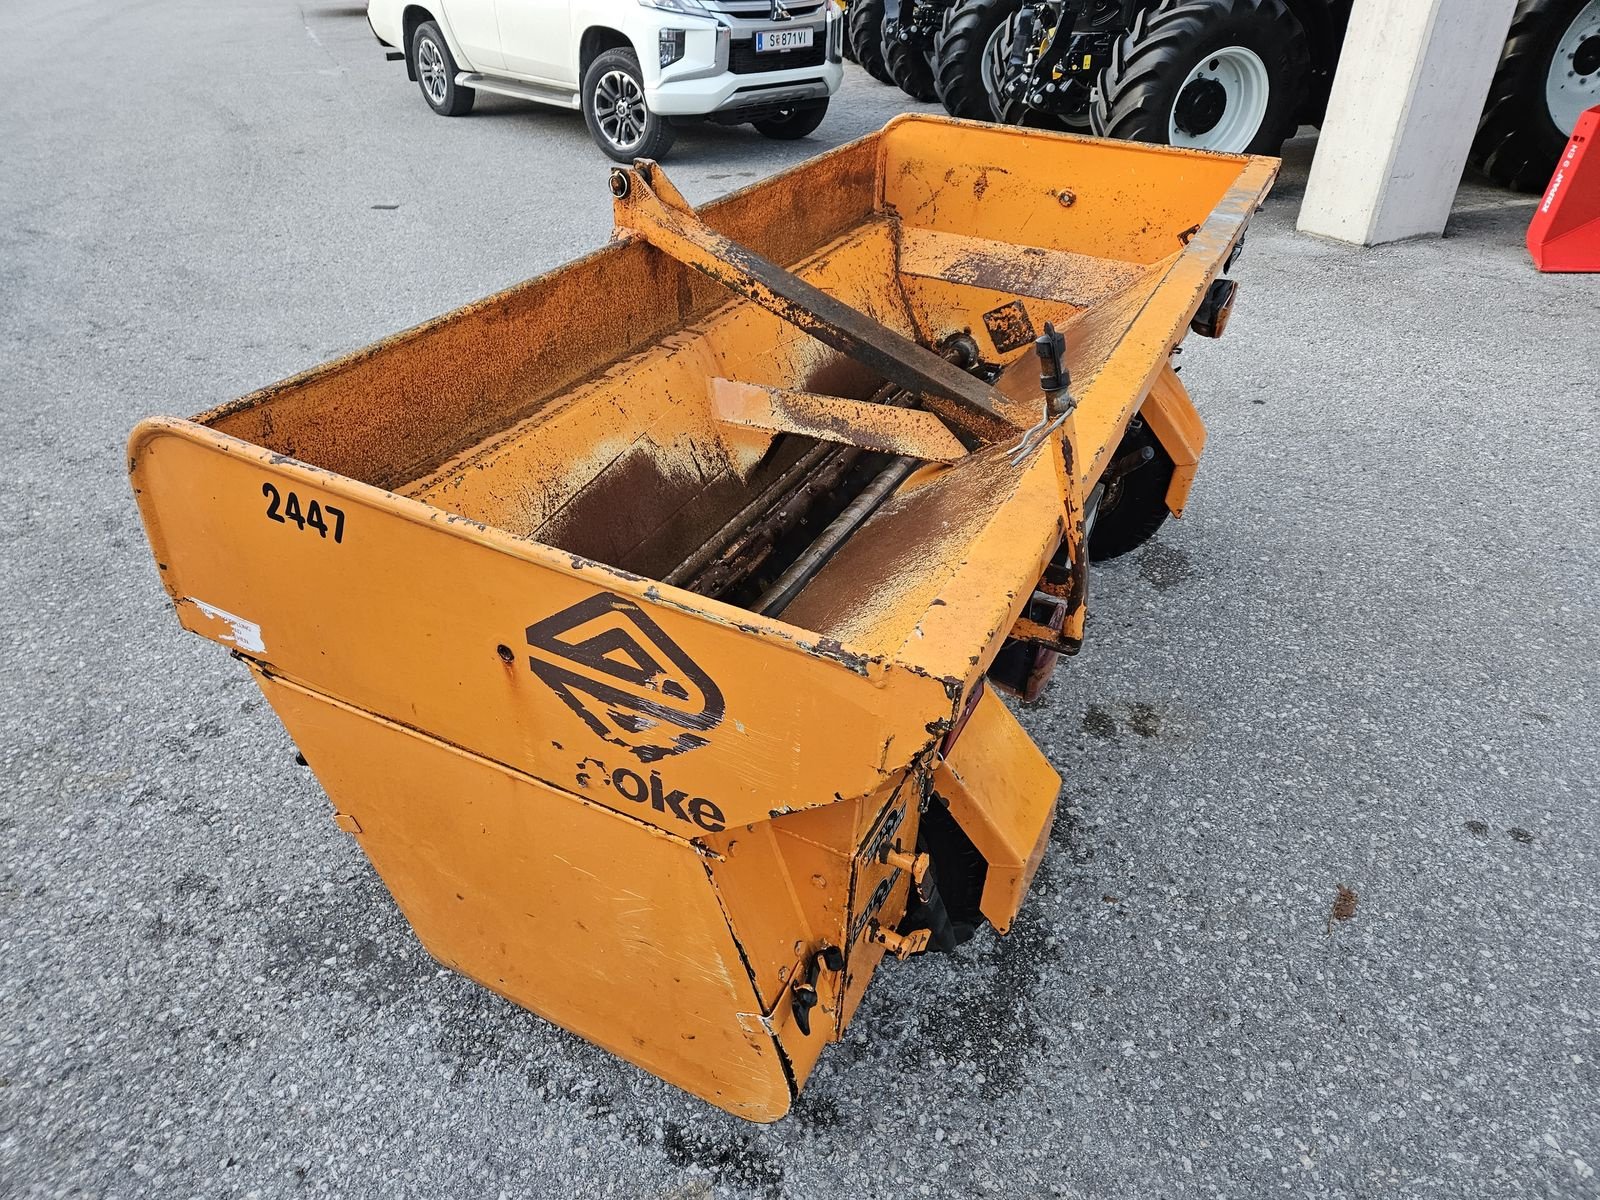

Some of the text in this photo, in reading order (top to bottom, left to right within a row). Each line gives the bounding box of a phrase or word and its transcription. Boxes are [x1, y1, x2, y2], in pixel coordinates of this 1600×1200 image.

[1542, 172, 1564, 213] KRPAN
[1567, 144, 1578, 159] EH
[262, 482, 346, 544] 2447
[566, 750, 726, 833] oke
